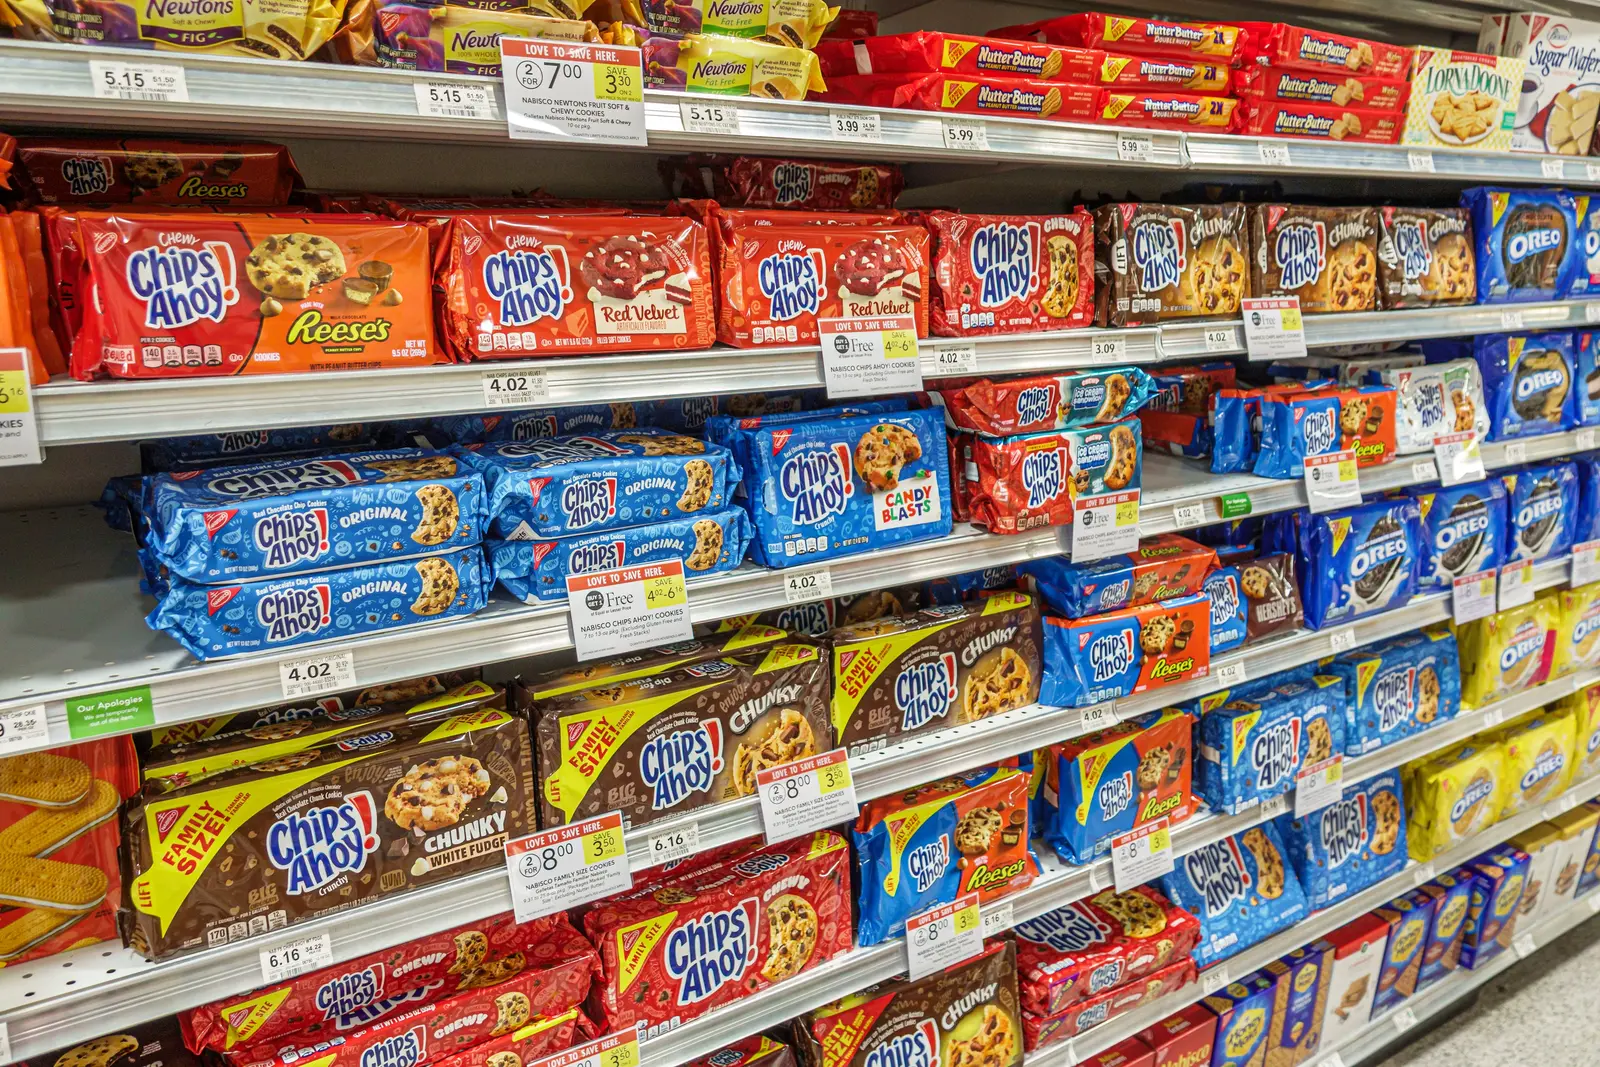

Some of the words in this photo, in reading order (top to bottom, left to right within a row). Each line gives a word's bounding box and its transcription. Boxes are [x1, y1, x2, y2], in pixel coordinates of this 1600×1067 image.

[146, 0, 233, 18] Newtons
[479, 1, 497, 10] FIG
[708, 0, 763, 18] Newtons
[182, 33, 206, 42] FIG
[525, 44, 549, 56] LOVE
[553, 46, 564, 56] TO
[596, 50, 619, 62] HERE.
[1530, 42, 1566, 74] Sugar
[478, 67, 496, 75] FIG
[525, 64, 532, 75] 2
[607, 66, 627, 75] SAVE
[692, 60, 746, 79] Newtons
[106, 72, 144, 87] 5.15
[431, 89, 461, 102] 5.15
[554, 100, 587, 108] NEWTONS
[691, 108, 723, 121] 5.15
[837, 120, 859, 132] 3.99
[949, 129, 973, 140] 5.99
[1122, 141, 1137, 151] 5.99
[819, 174, 851, 184] CHEWY
[1429, 218, 1466, 242] CHUNKY
[972, 226, 1028, 276] Chips
[1509, 230, 1561, 259] OREO
[131, 249, 215, 300] Chips
[150, 279, 239, 326] Ahoy!
[601, 306, 631, 323] Red
[632, 306, 680, 321] Velvet
[287, 310, 392, 344] Reese's
[1209, 332, 1226, 342] 4.02
[254, 353, 280, 362] COOKIES
[1096, 344, 1115, 354] 3.09
[490, 378, 527, 392] 4.02
[1518, 371, 1563, 398] OREO
[351, 451, 424, 463] ORIGINAL
[602, 470, 617, 478] Cookies
[782, 452, 838, 496] Chips
[564, 479, 607, 506] Chips
[625, 478, 676, 495] ORIGINAL
[885, 486, 932, 507] CANDY
[253, 508, 266, 518] Real
[267, 503, 292, 515] Chocolate
[306, 499, 328, 509] Cookies
[340, 506, 408, 528] ORIGINAL
[882, 500, 931, 523] BLASTS
[1094, 511, 1109, 523] Free
[1178, 509, 1191, 519] 4.02
[1518, 496, 1562, 527] OREO
[258, 512, 316, 544] Chips
[1436, 515, 1489, 550] OREO
[1350, 539, 1408, 577] OREO
[268, 581, 294, 593] Chocolate
[309, 576, 330, 586] Cookies
[588, 576, 607, 586] LOVE
[611, 574, 620, 583] TO
[623, 570, 641, 580] SAVE
[645, 567, 665, 577] HERE.
[655, 578, 673, 586] SAVE
[342, 580, 408, 603] ORIGINAL
[606, 592, 633, 607] Free
[1256, 600, 1296, 622] HERSHEY'S
[581, 622, 611, 632] NABISCO
[612, 619, 632, 628] CHIPS
[633, 614, 654, 624] AHOY!
[655, 609, 683, 619] COOKIES
[962, 627, 1017, 665] CHUNKY
[1333, 634, 1348, 644] 5.75
[1092, 636, 1126, 665] Chips
[1500, 634, 1544, 670] OREO
[289, 663, 331, 681] 4.02
[840, 647, 873, 692] FAMILY
[848, 655, 880, 699] SIZE!
[1221, 666, 1236, 677] 4.02
[77, 705, 94, 713] Our
[98, 696, 143, 710] Apologies
[107, 707, 139, 717] temporarily
[1084, 709, 1103, 721] 4.02
[772, 769, 787, 780] LOVE
[790, 766, 798, 774] TO
[801, 762, 815, 771] SAVE
[817, 756, 833, 766] HERE.
[288, 800, 309, 812] Chocolate
[310, 794, 324, 803] Chunk
[325, 791, 343, 800] Cookies
[775, 806, 796, 816] NABISCO
[797, 801, 813, 809] FAMILY
[824, 791, 845, 801] COOKIES
[162, 800, 214, 866] FAMILY
[424, 811, 507, 852] CHUNKY
[525, 838, 545, 850] LOVE
[548, 833, 558, 843] TO
[562, 827, 580, 839] SAVE
[583, 821, 604, 833] HERE.
[593, 831, 611, 840] SAVE
[177, 810, 231, 876] SIZE!
[655, 834, 683, 851] 6.16
[430, 853, 468, 868] WHITE
[469, 836, 507, 860] FUDGE
[526, 857, 533, 866] 2
[524, 867, 538, 875] FOR
[525, 879, 553, 891] NABISCO
[554, 872, 575, 882] FAMILY
[575, 868, 588, 876] SIZE
[589, 860, 615, 872] COOKIES
[966, 860, 1025, 892] Reese's
[138, 881, 152, 908] LIFT
[319, 875, 349, 896] Crunchy
[1206, 864, 1250, 916] Ahoy!
[918, 915, 931, 924] LOVE
[985, 914, 999, 926] 6.16
[210, 929, 225, 940] 170
[270, 949, 300, 967] 6.16
[941, 983, 997, 1030] CHUNKY
[434, 1013, 488, 1039] CHEWY
[581, 1045, 599, 1057] SAVE
